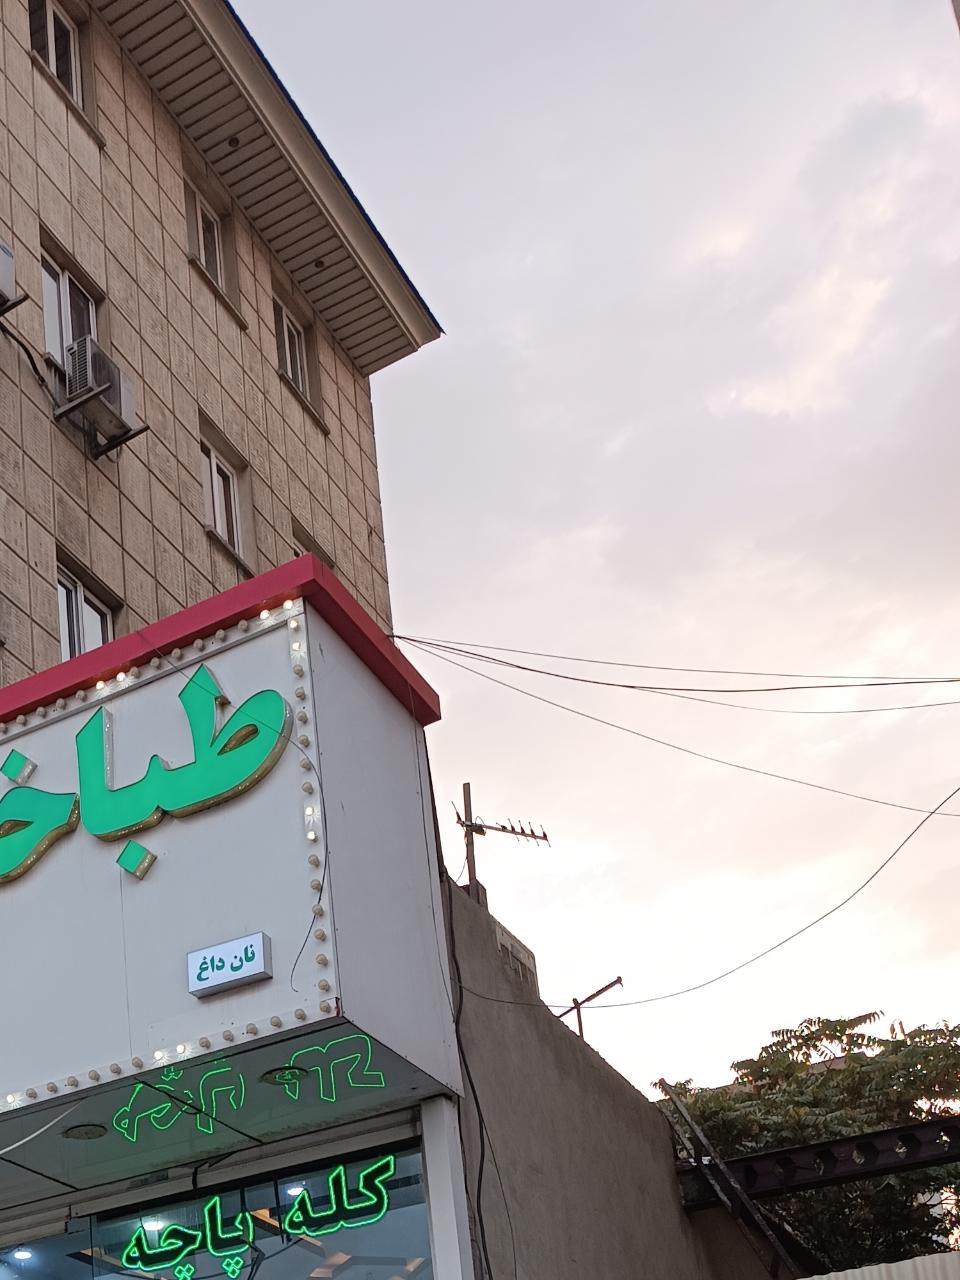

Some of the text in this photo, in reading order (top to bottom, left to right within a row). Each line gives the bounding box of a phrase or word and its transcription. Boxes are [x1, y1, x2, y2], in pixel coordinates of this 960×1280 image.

[197, 944, 256, 982] نان داغ
[283, 1154, 395, 1237] کله
